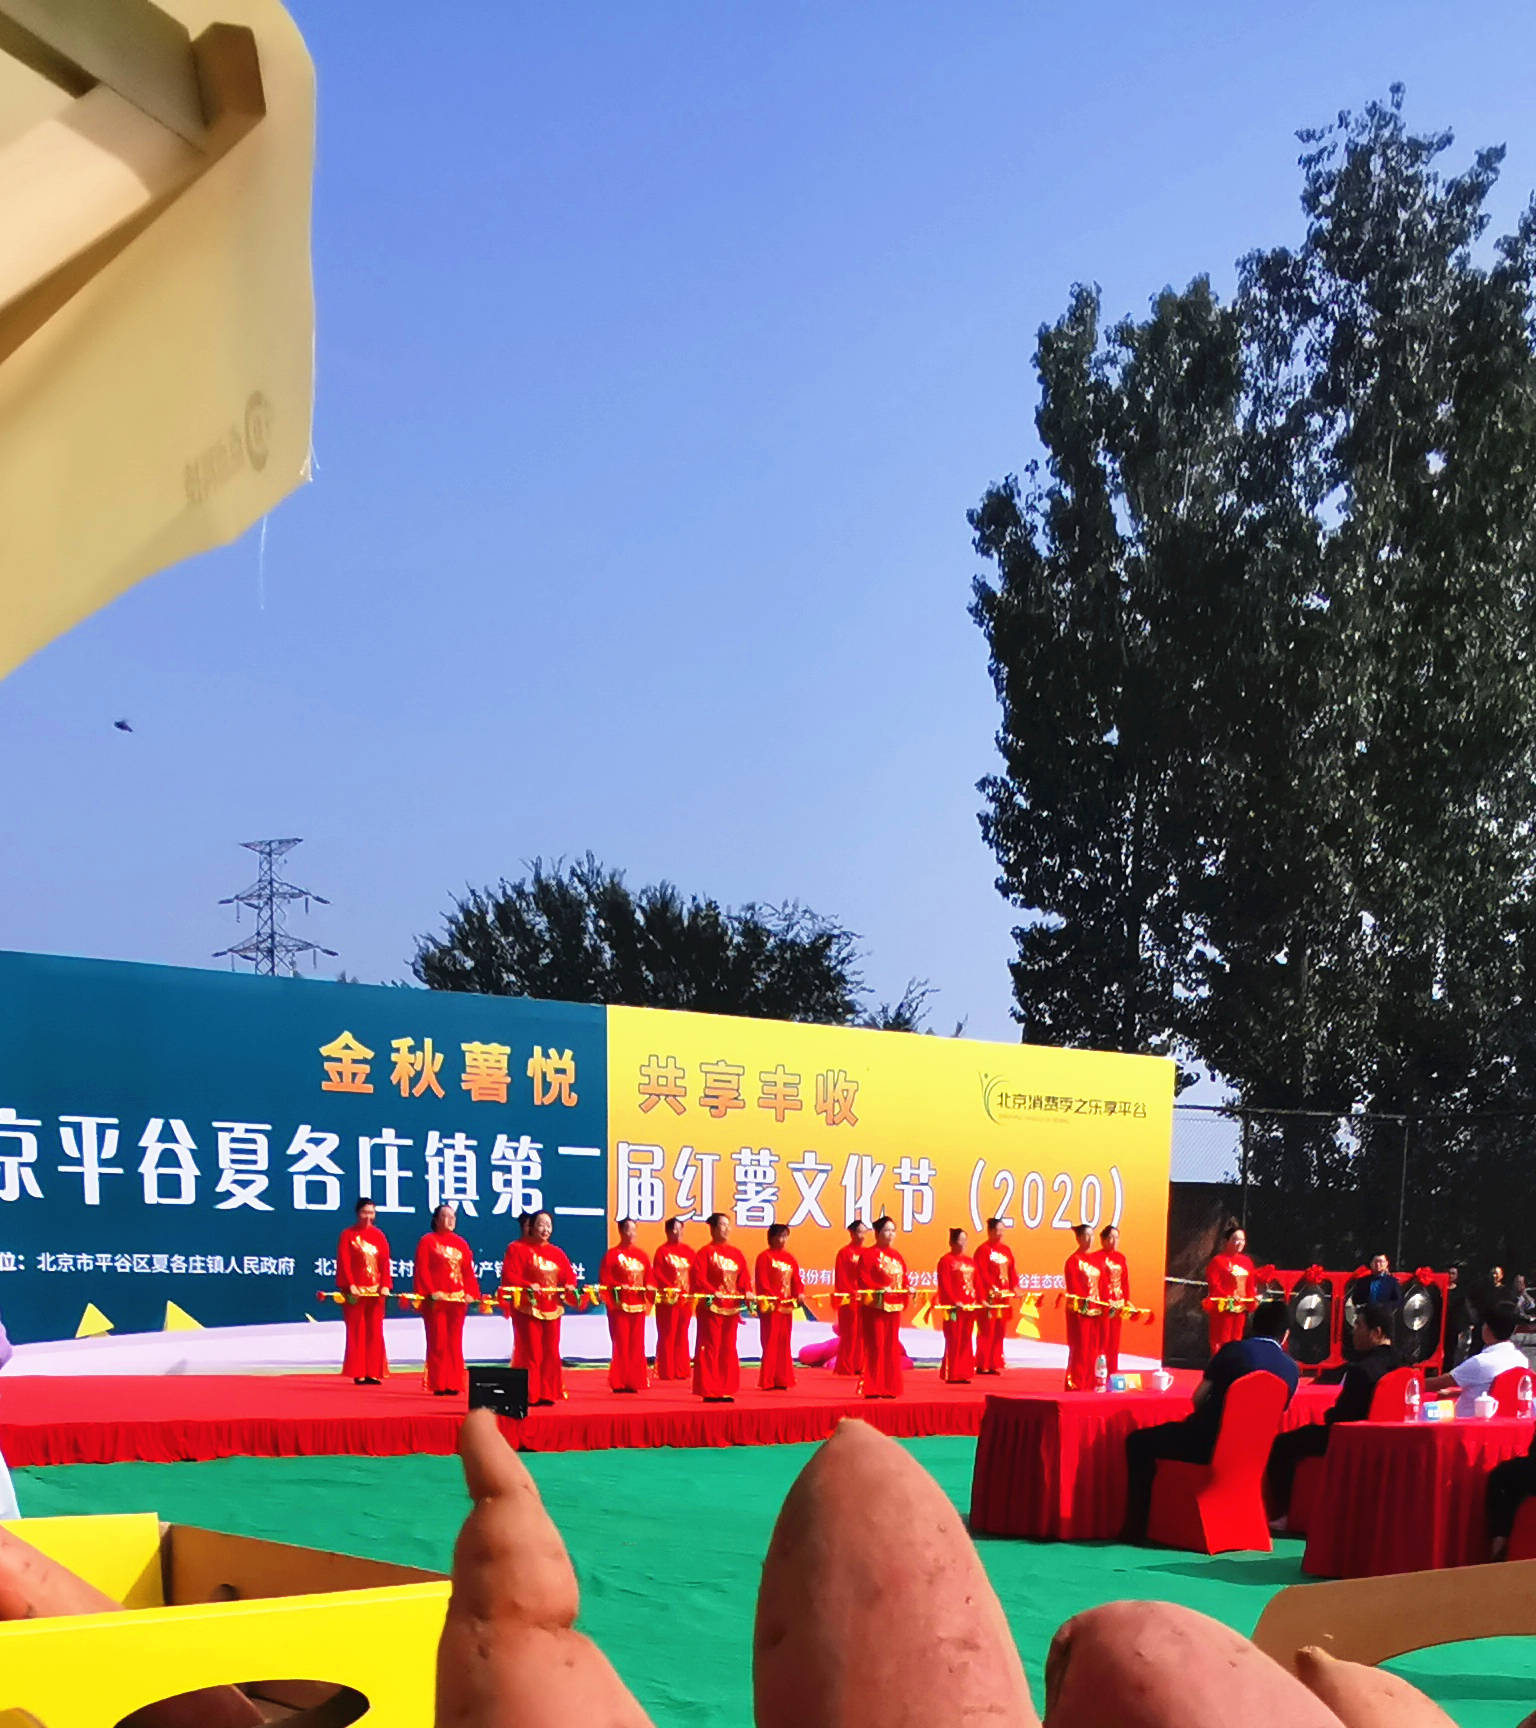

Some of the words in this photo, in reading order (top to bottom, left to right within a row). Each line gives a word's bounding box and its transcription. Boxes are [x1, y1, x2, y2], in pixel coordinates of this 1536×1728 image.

[320, 1030, 578, 1107] 金秋薯悦
[638, 1054, 860, 1127] 共享丰收
[996, 1092, 1147, 1119] 北京消费季之乐享平谷
